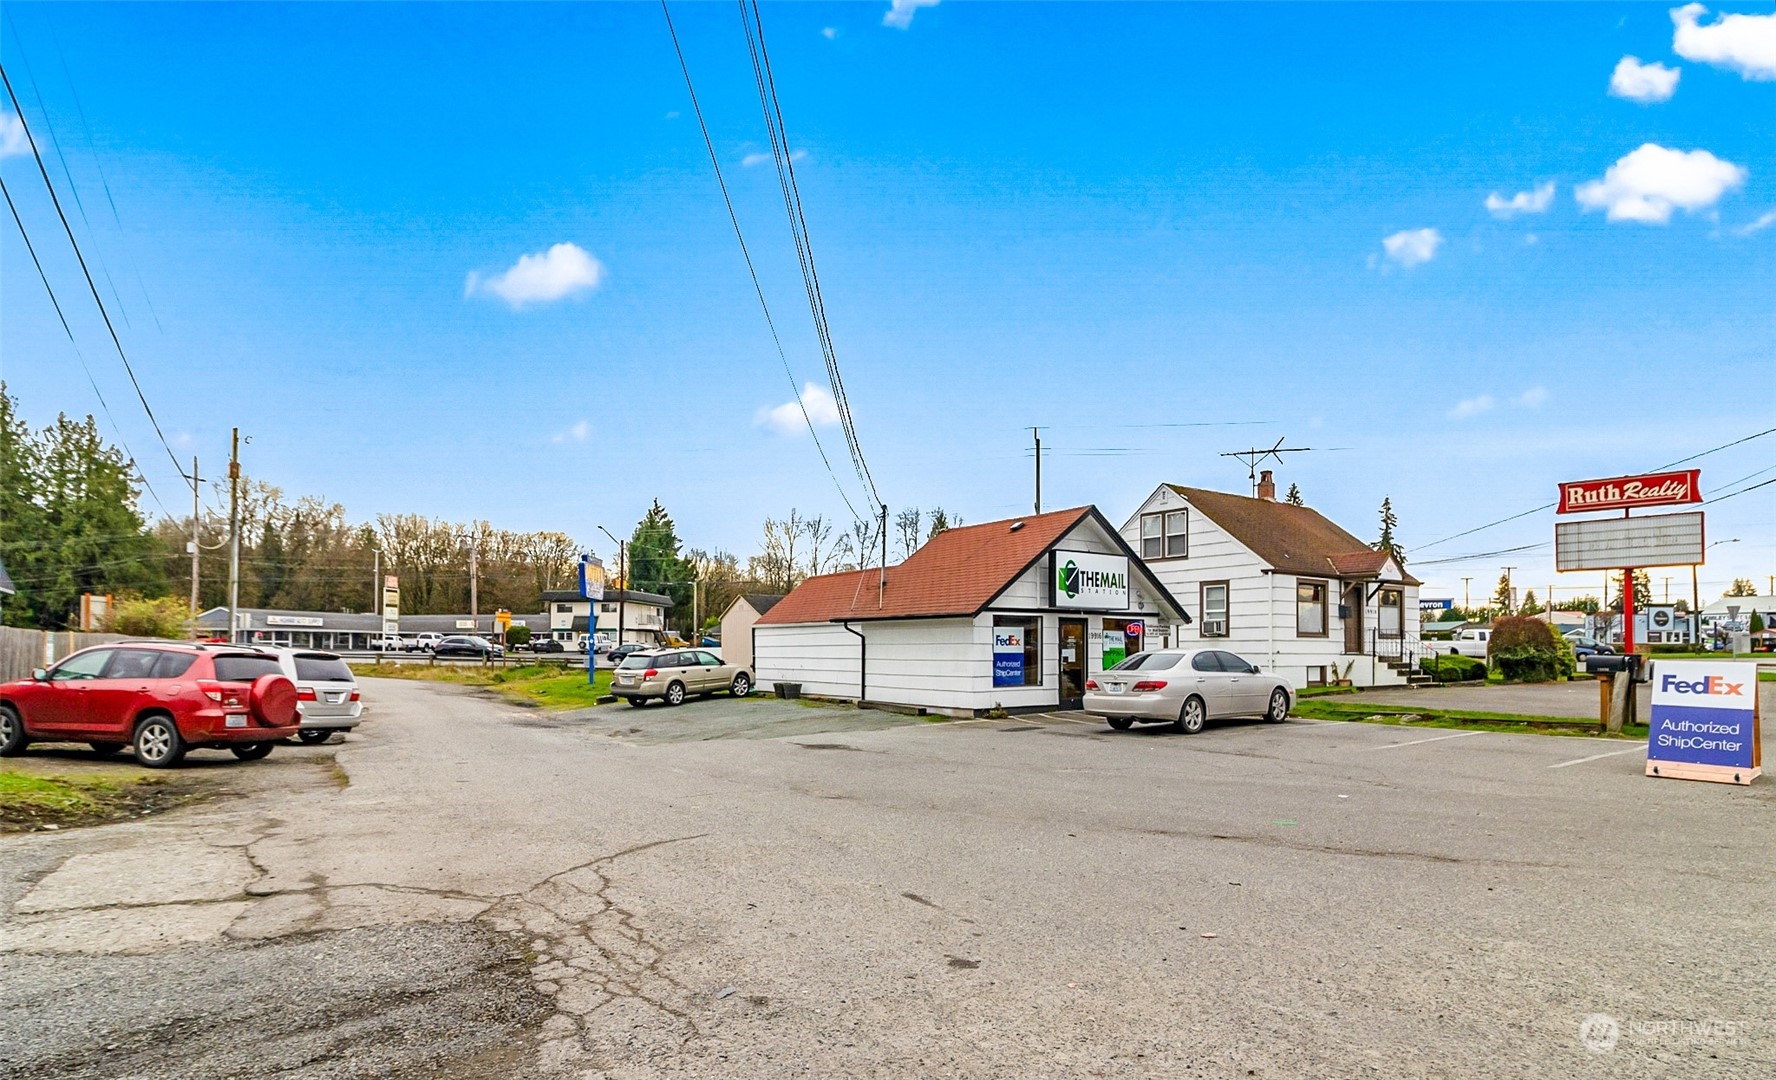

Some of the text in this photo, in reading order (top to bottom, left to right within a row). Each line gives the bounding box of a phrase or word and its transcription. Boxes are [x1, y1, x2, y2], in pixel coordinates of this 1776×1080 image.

[1568, 480, 1688, 505] Ruth Realty
[995, 634, 1021, 646] FedEx
[995, 669, 1022, 677] ShipCenter
[1661, 674, 1744, 696] FedEx
[1660, 719, 1740, 735] Authorized
[1657, 734, 1743, 752] ShipCenter
